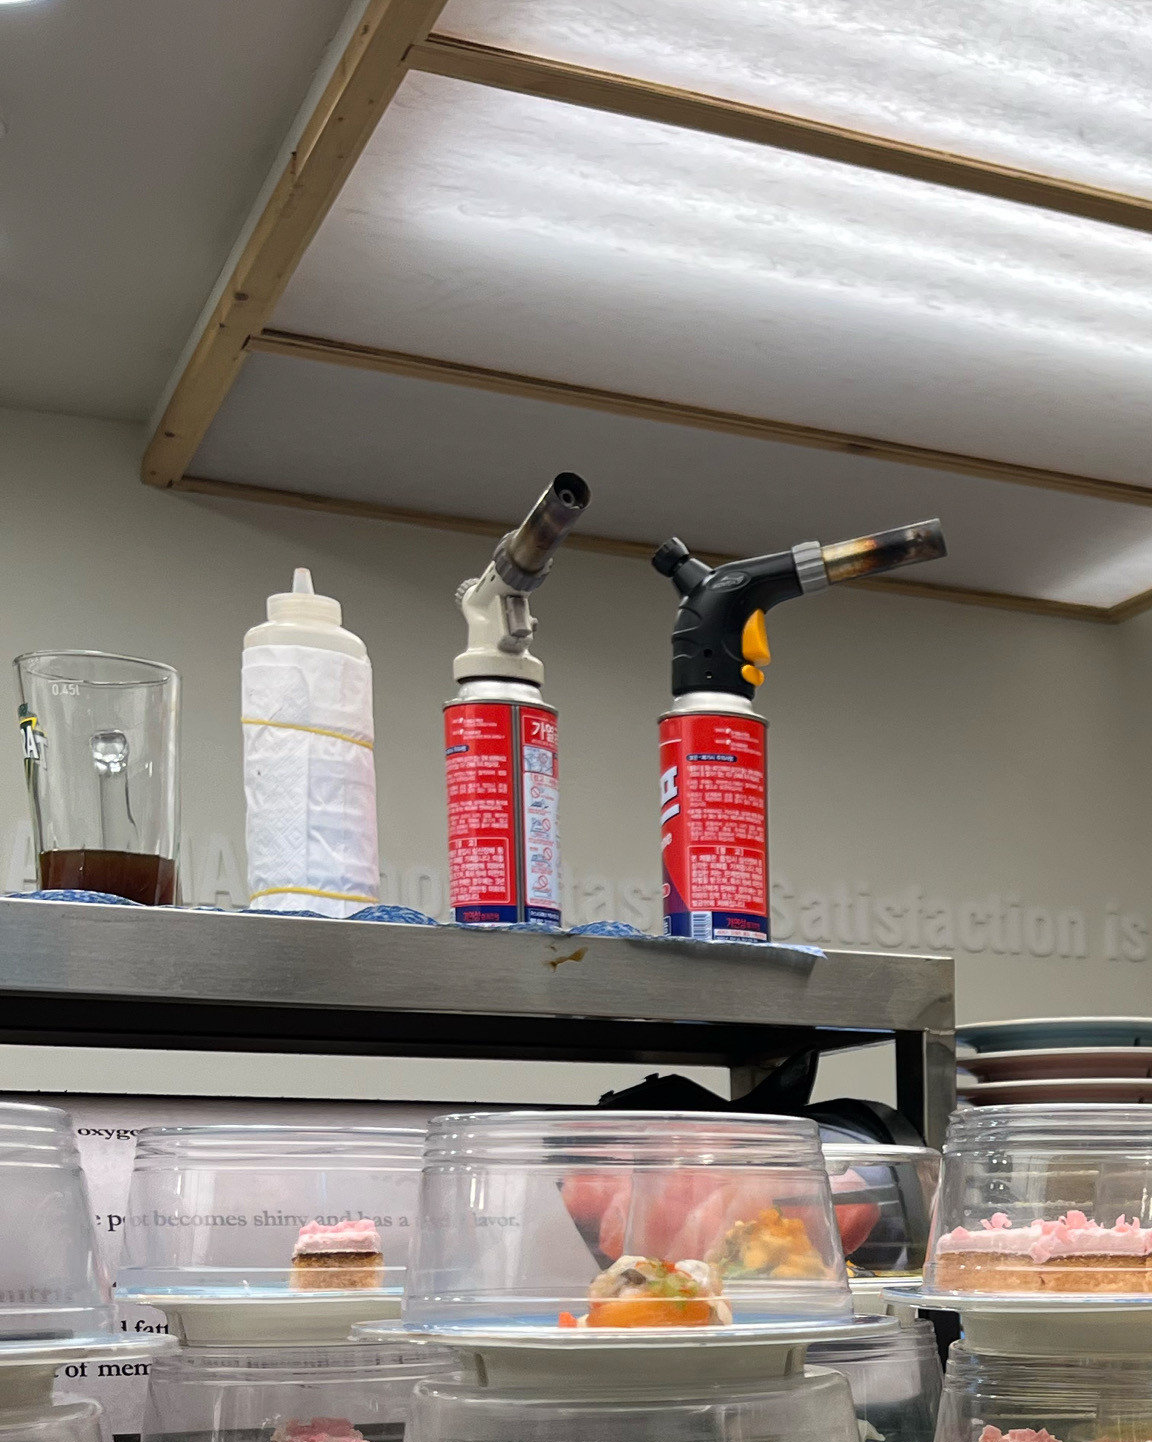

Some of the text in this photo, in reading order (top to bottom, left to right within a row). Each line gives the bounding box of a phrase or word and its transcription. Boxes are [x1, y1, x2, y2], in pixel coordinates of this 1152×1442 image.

[770, 880, 1088, 960] Satisfaction
[1104, 902, 1148, 962] is
[153, 1210, 248, 1227] becomes
[254, 1210, 308, 1231] shiny
[314, 1210, 351, 1227] and
[134, 1320, 169, 1334] fatt
